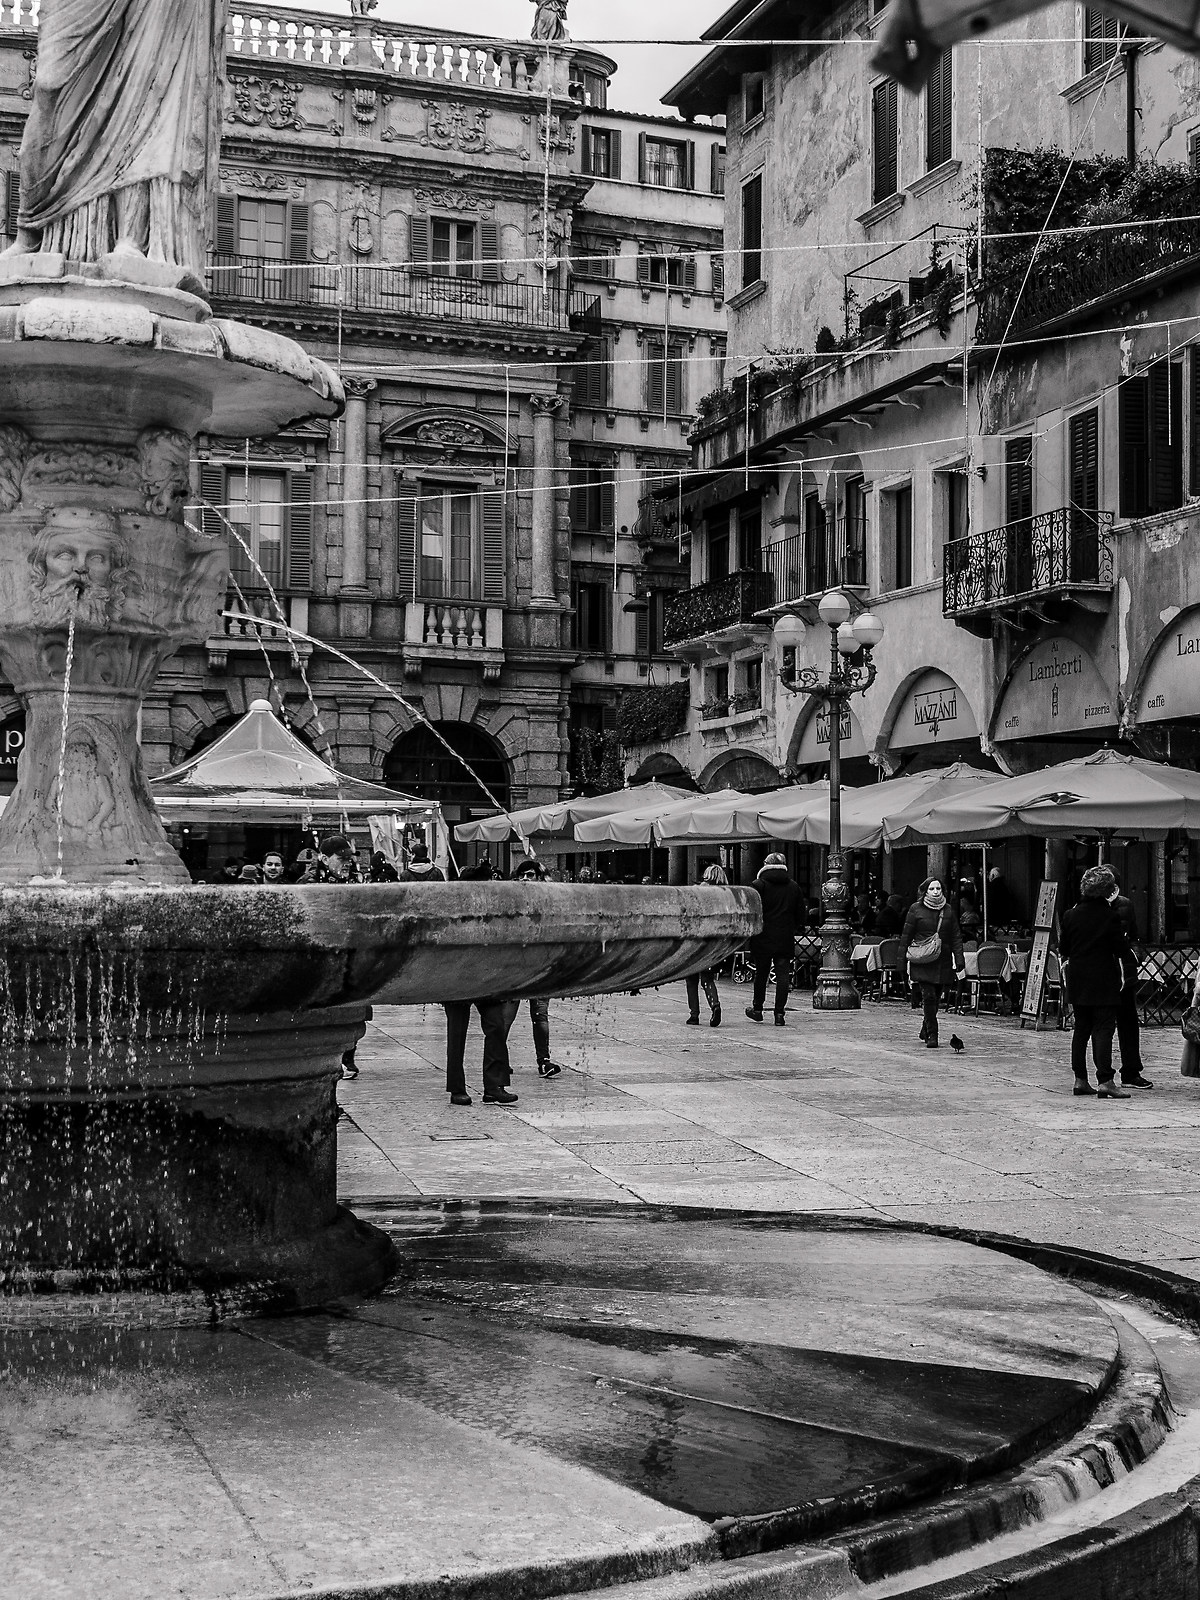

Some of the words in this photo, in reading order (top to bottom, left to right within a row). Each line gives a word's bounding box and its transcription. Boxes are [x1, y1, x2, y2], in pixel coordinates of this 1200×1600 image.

[1051, 640, 1059, 652] Ai
[1029, 654, 1082, 682] Lamberti
[915, 700, 957, 723] MAZZANTI
[1085, 702, 1110, 719] pizzeria
